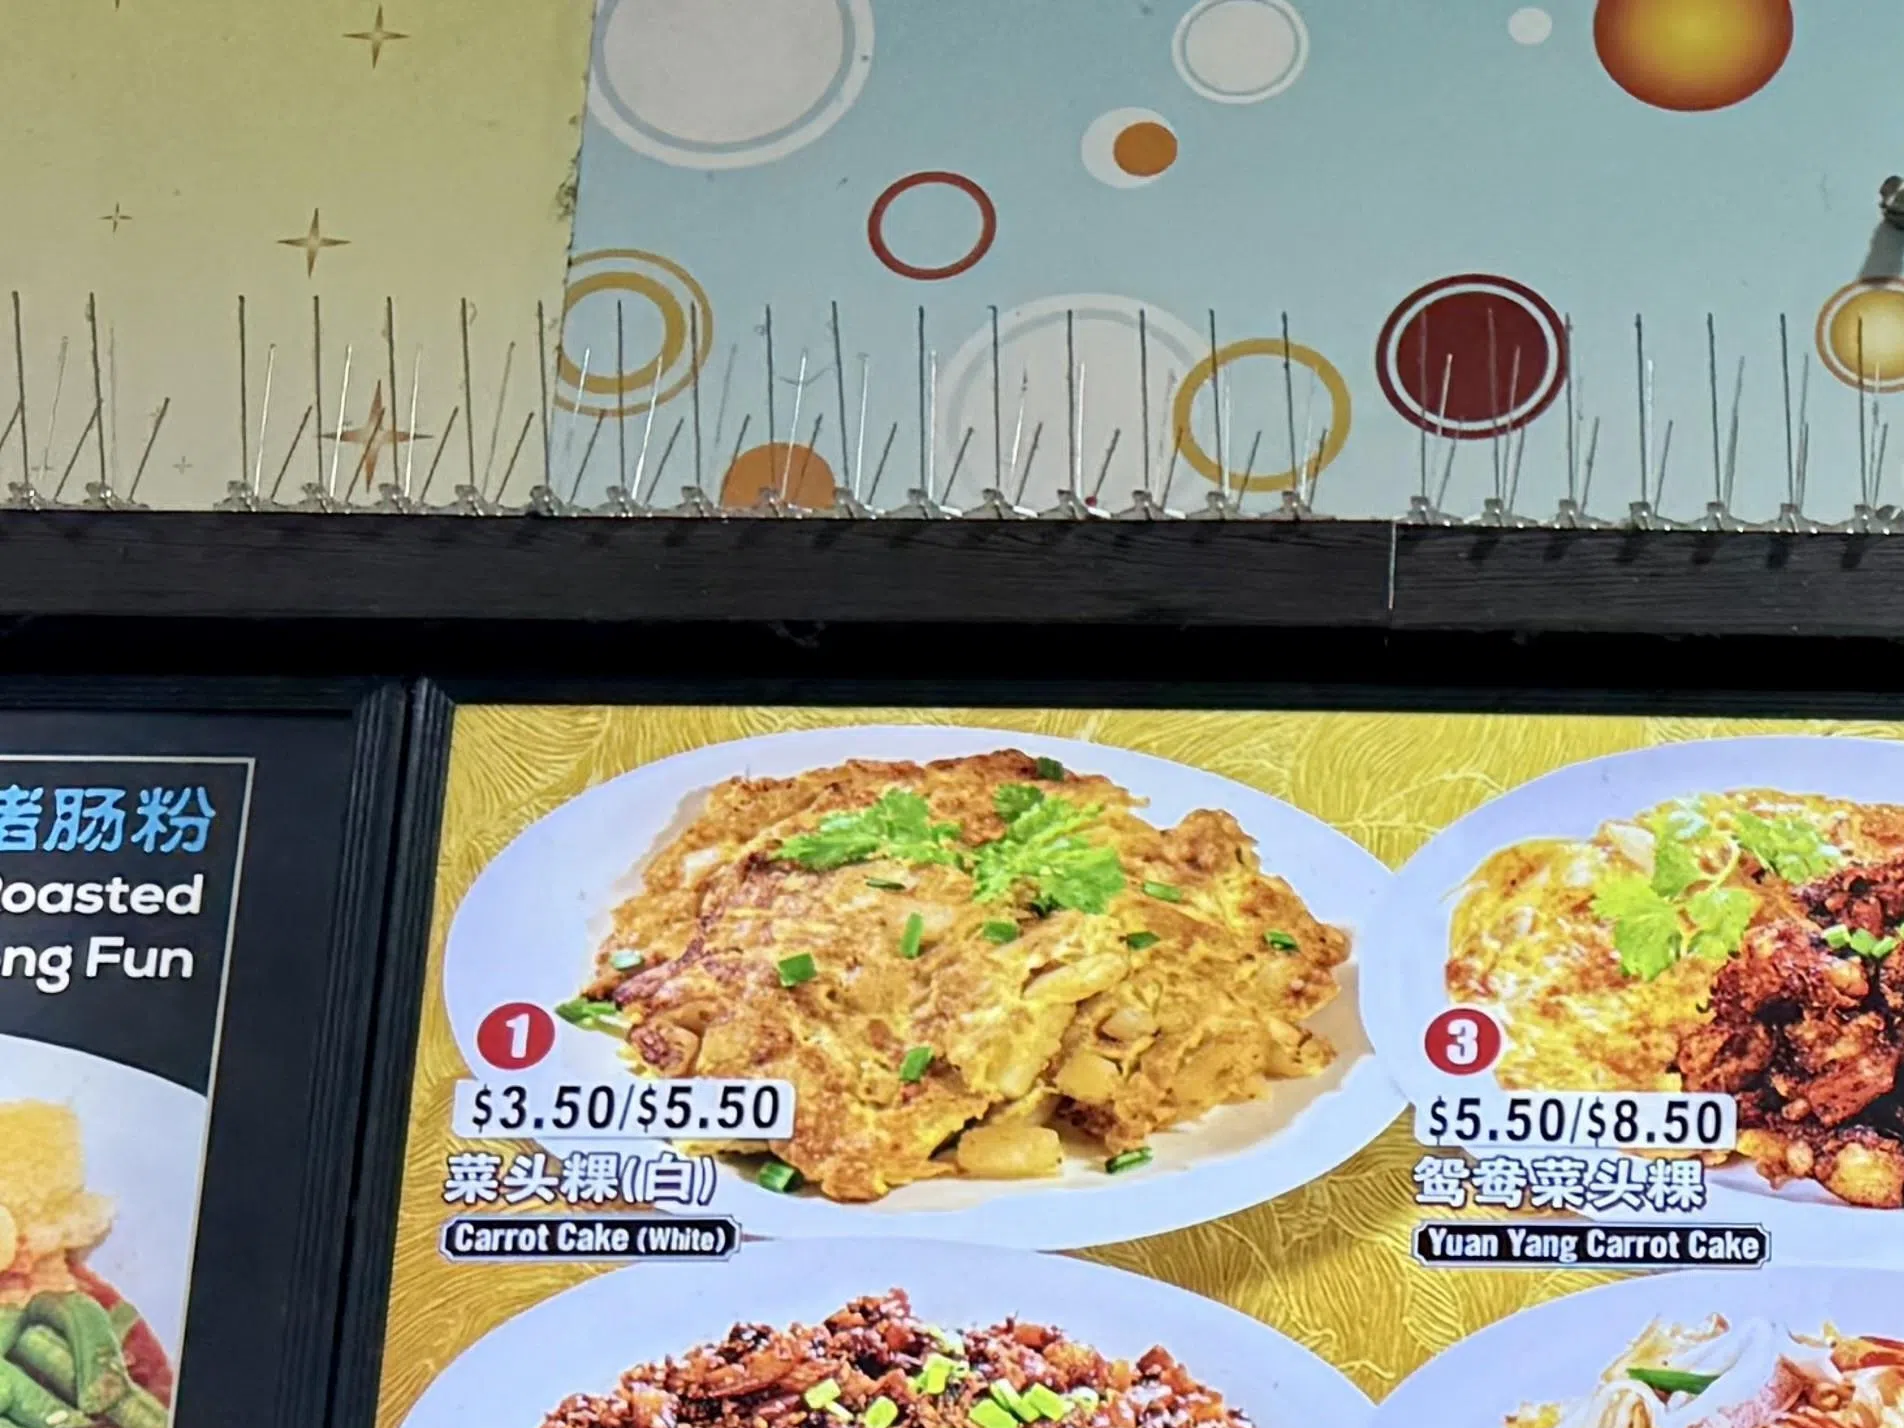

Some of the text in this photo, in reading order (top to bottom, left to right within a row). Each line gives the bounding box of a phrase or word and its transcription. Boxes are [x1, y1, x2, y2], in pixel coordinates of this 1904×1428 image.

[0, 873, 204, 915] oasted
[0, 936, 194, 993] ng Fun
[505, 1013, 531, 1059] 1
[1446, 1019, 1480, 1065] 3
[471, 1083, 780, 1133] $3.50/$5.50
[1429, 1095, 1722, 1148] $5.50/$8.50
[443, 1151, 717, 1205] 菜头粿(白)
[1413, 1155, 1708, 1212] 鸳鸯菜头粿
[455, 1222, 726, 1252] Carrot Cake (White)
[1428, 1228, 1759, 1262] Yuan Yang Carrot Cake
